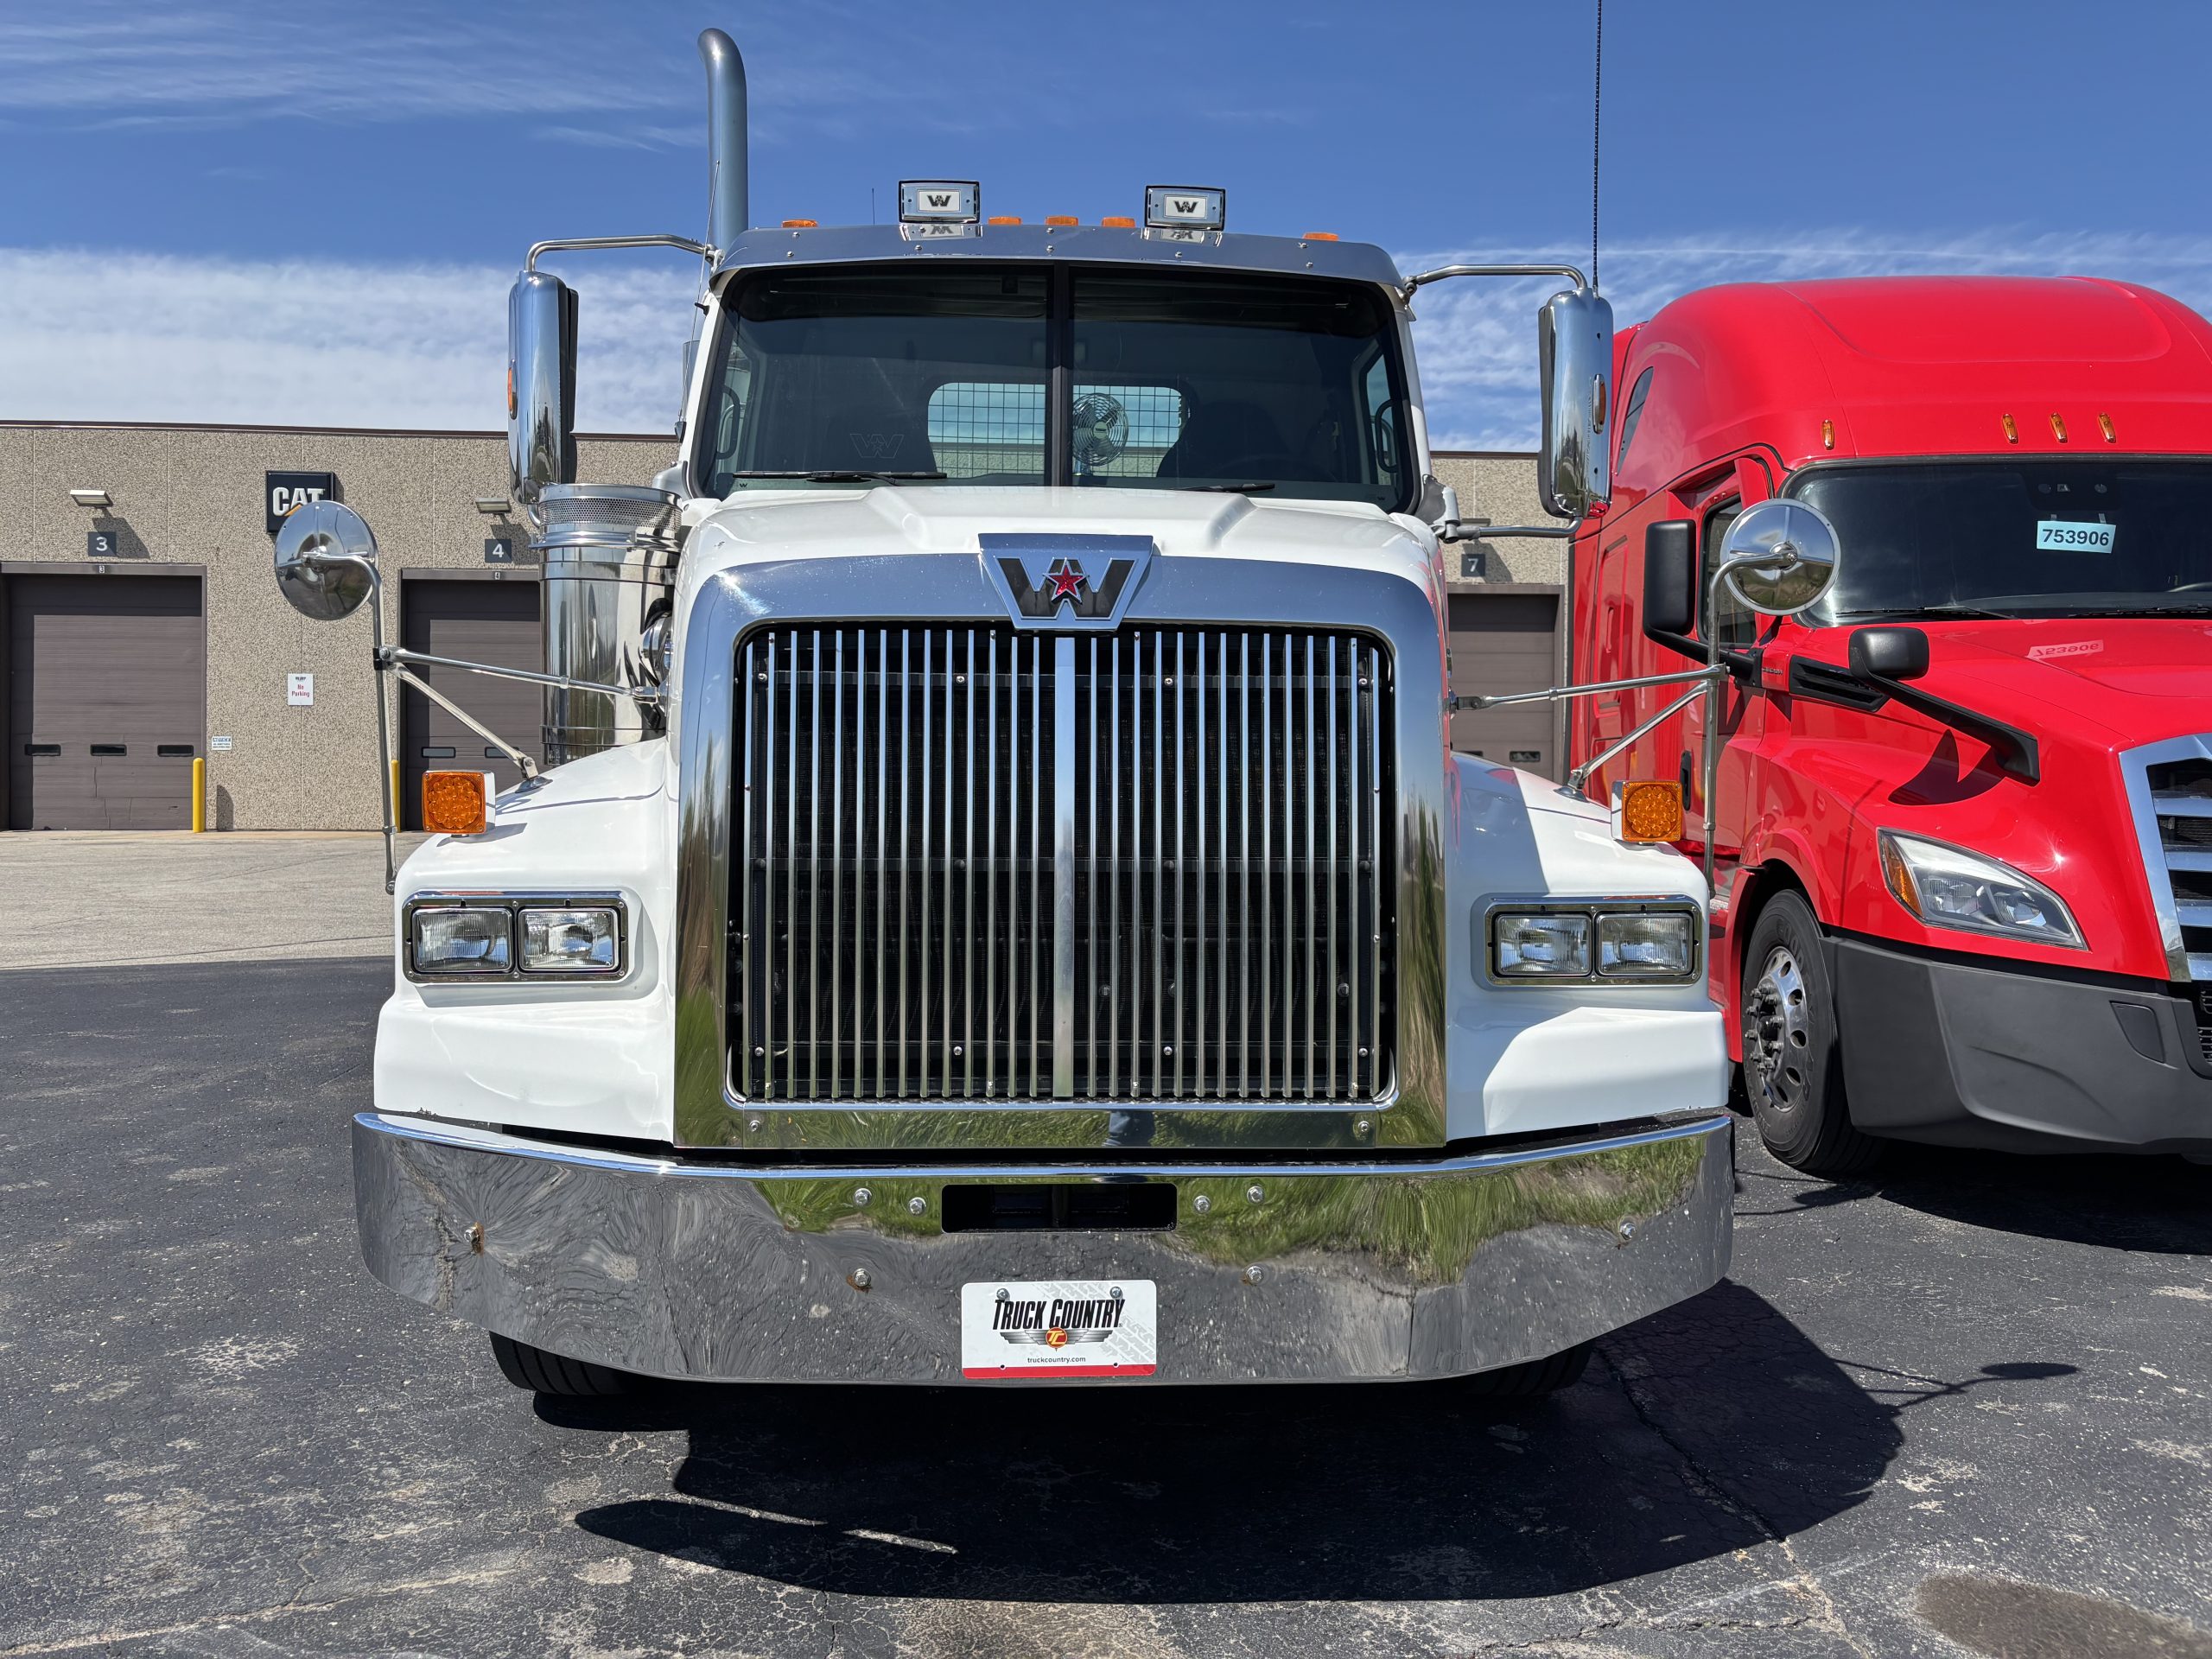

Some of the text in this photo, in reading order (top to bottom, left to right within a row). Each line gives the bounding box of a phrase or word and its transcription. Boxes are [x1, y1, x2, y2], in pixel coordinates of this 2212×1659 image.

[272, 486, 325, 517] CAT
[96, 536, 108, 551] 3
[2042, 528, 2110, 546] 753906
[493, 543, 504, 558] 4
[1468, 557, 1478, 572] 7
[993, 1299, 1126, 1330] TRUCK COUNTRY
[1046, 1330, 1065, 1345] TC
